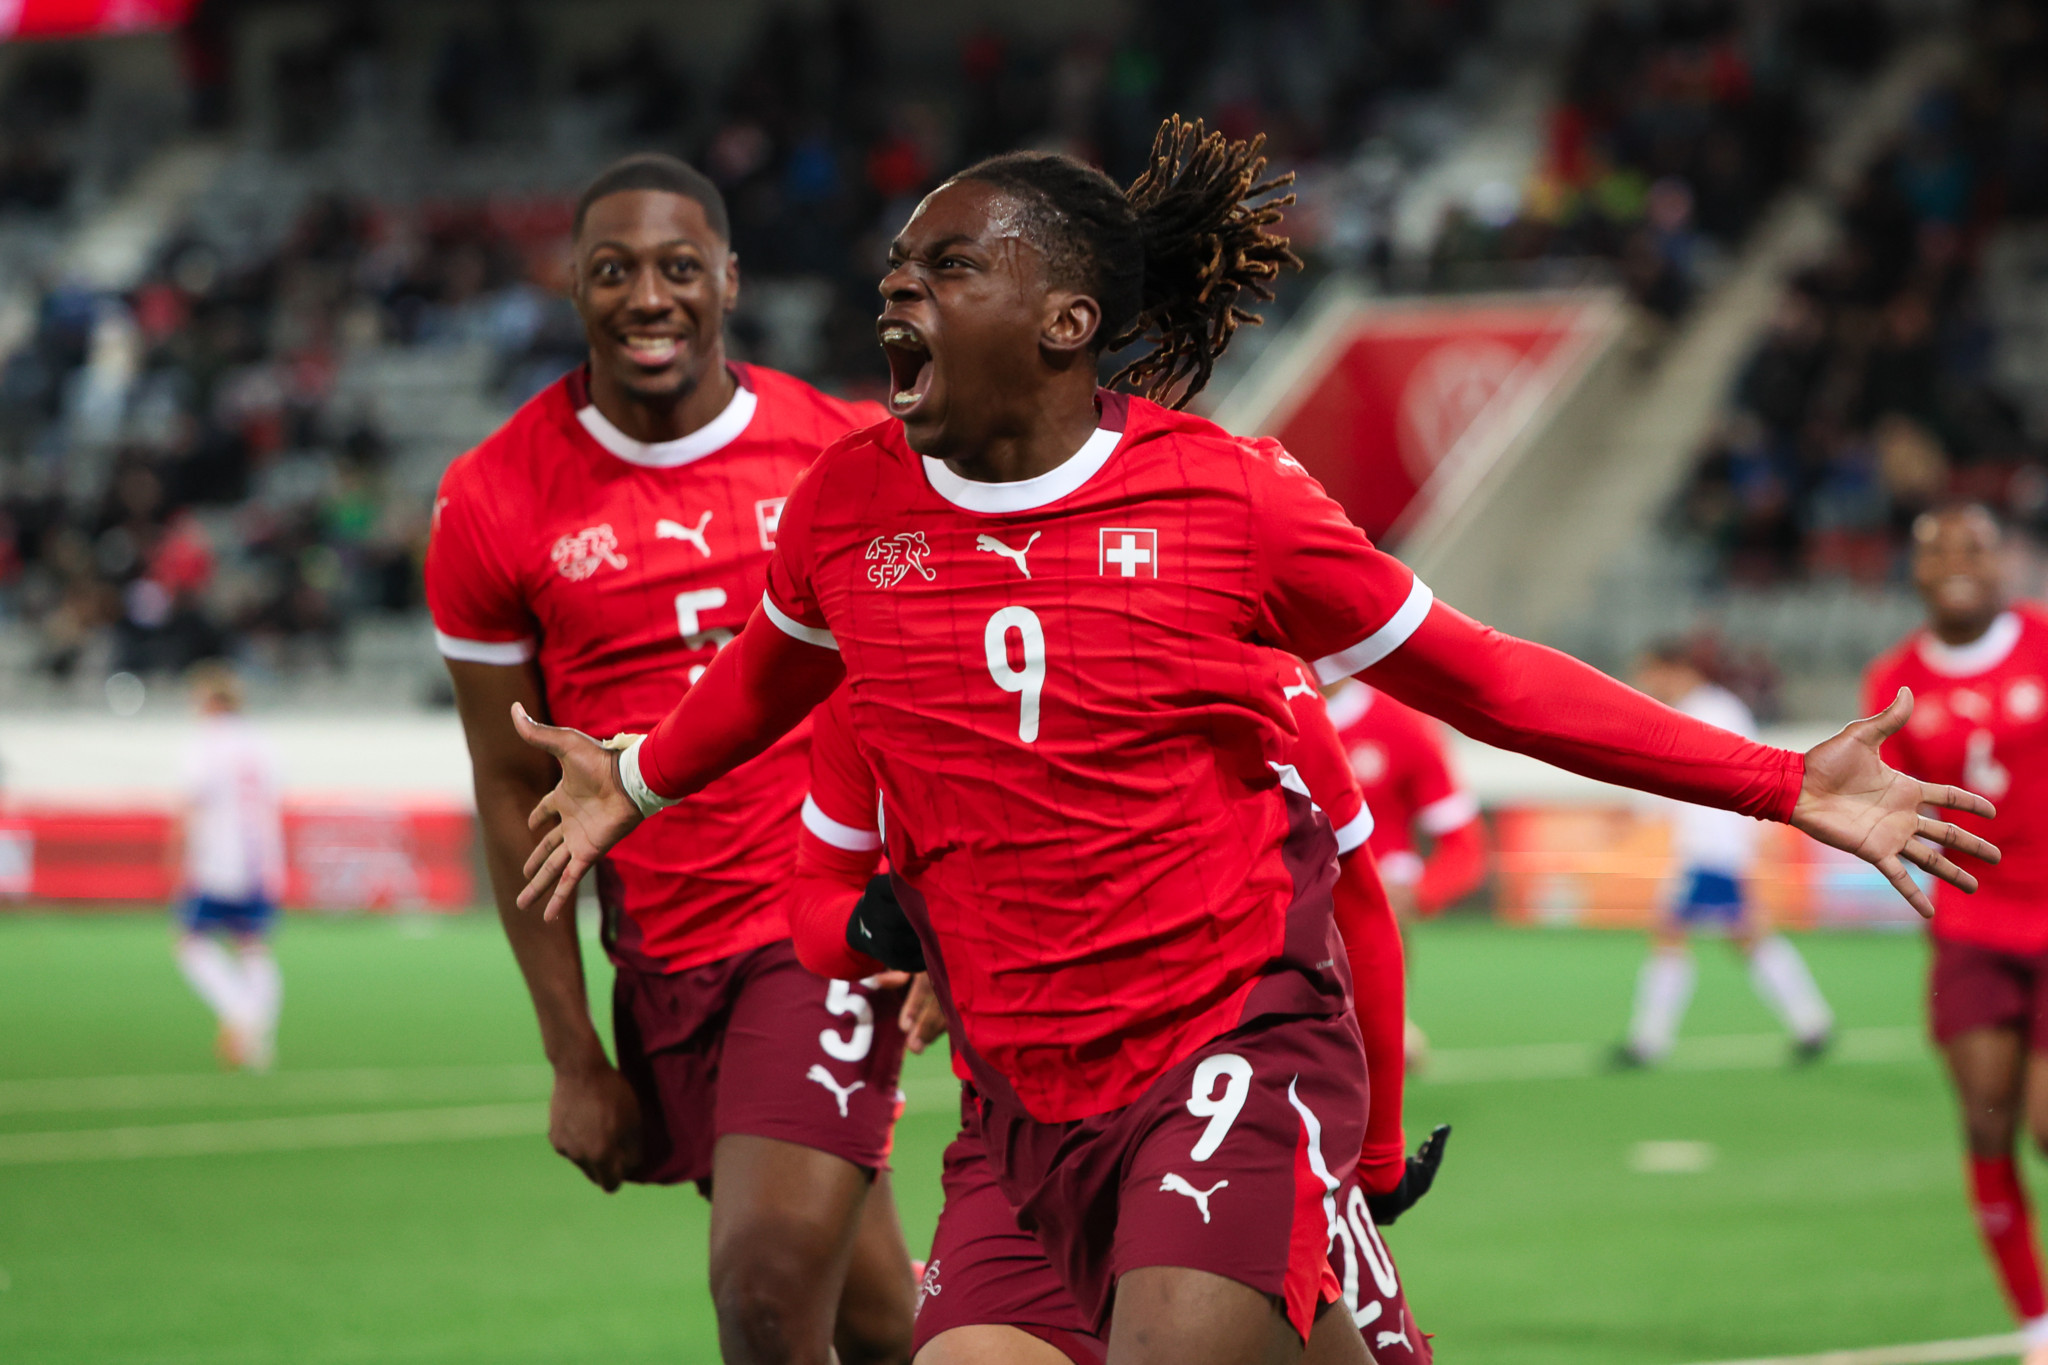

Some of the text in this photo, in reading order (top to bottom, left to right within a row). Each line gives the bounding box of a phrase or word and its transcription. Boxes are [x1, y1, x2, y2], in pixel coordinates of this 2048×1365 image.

[675, 587, 735, 687] 5
[984, 605, 1046, 744] 9
[819, 977, 880, 1062] 5
[1186, 1053, 1254, 1162] 9
[1327, 1185, 1399, 1330] 20
